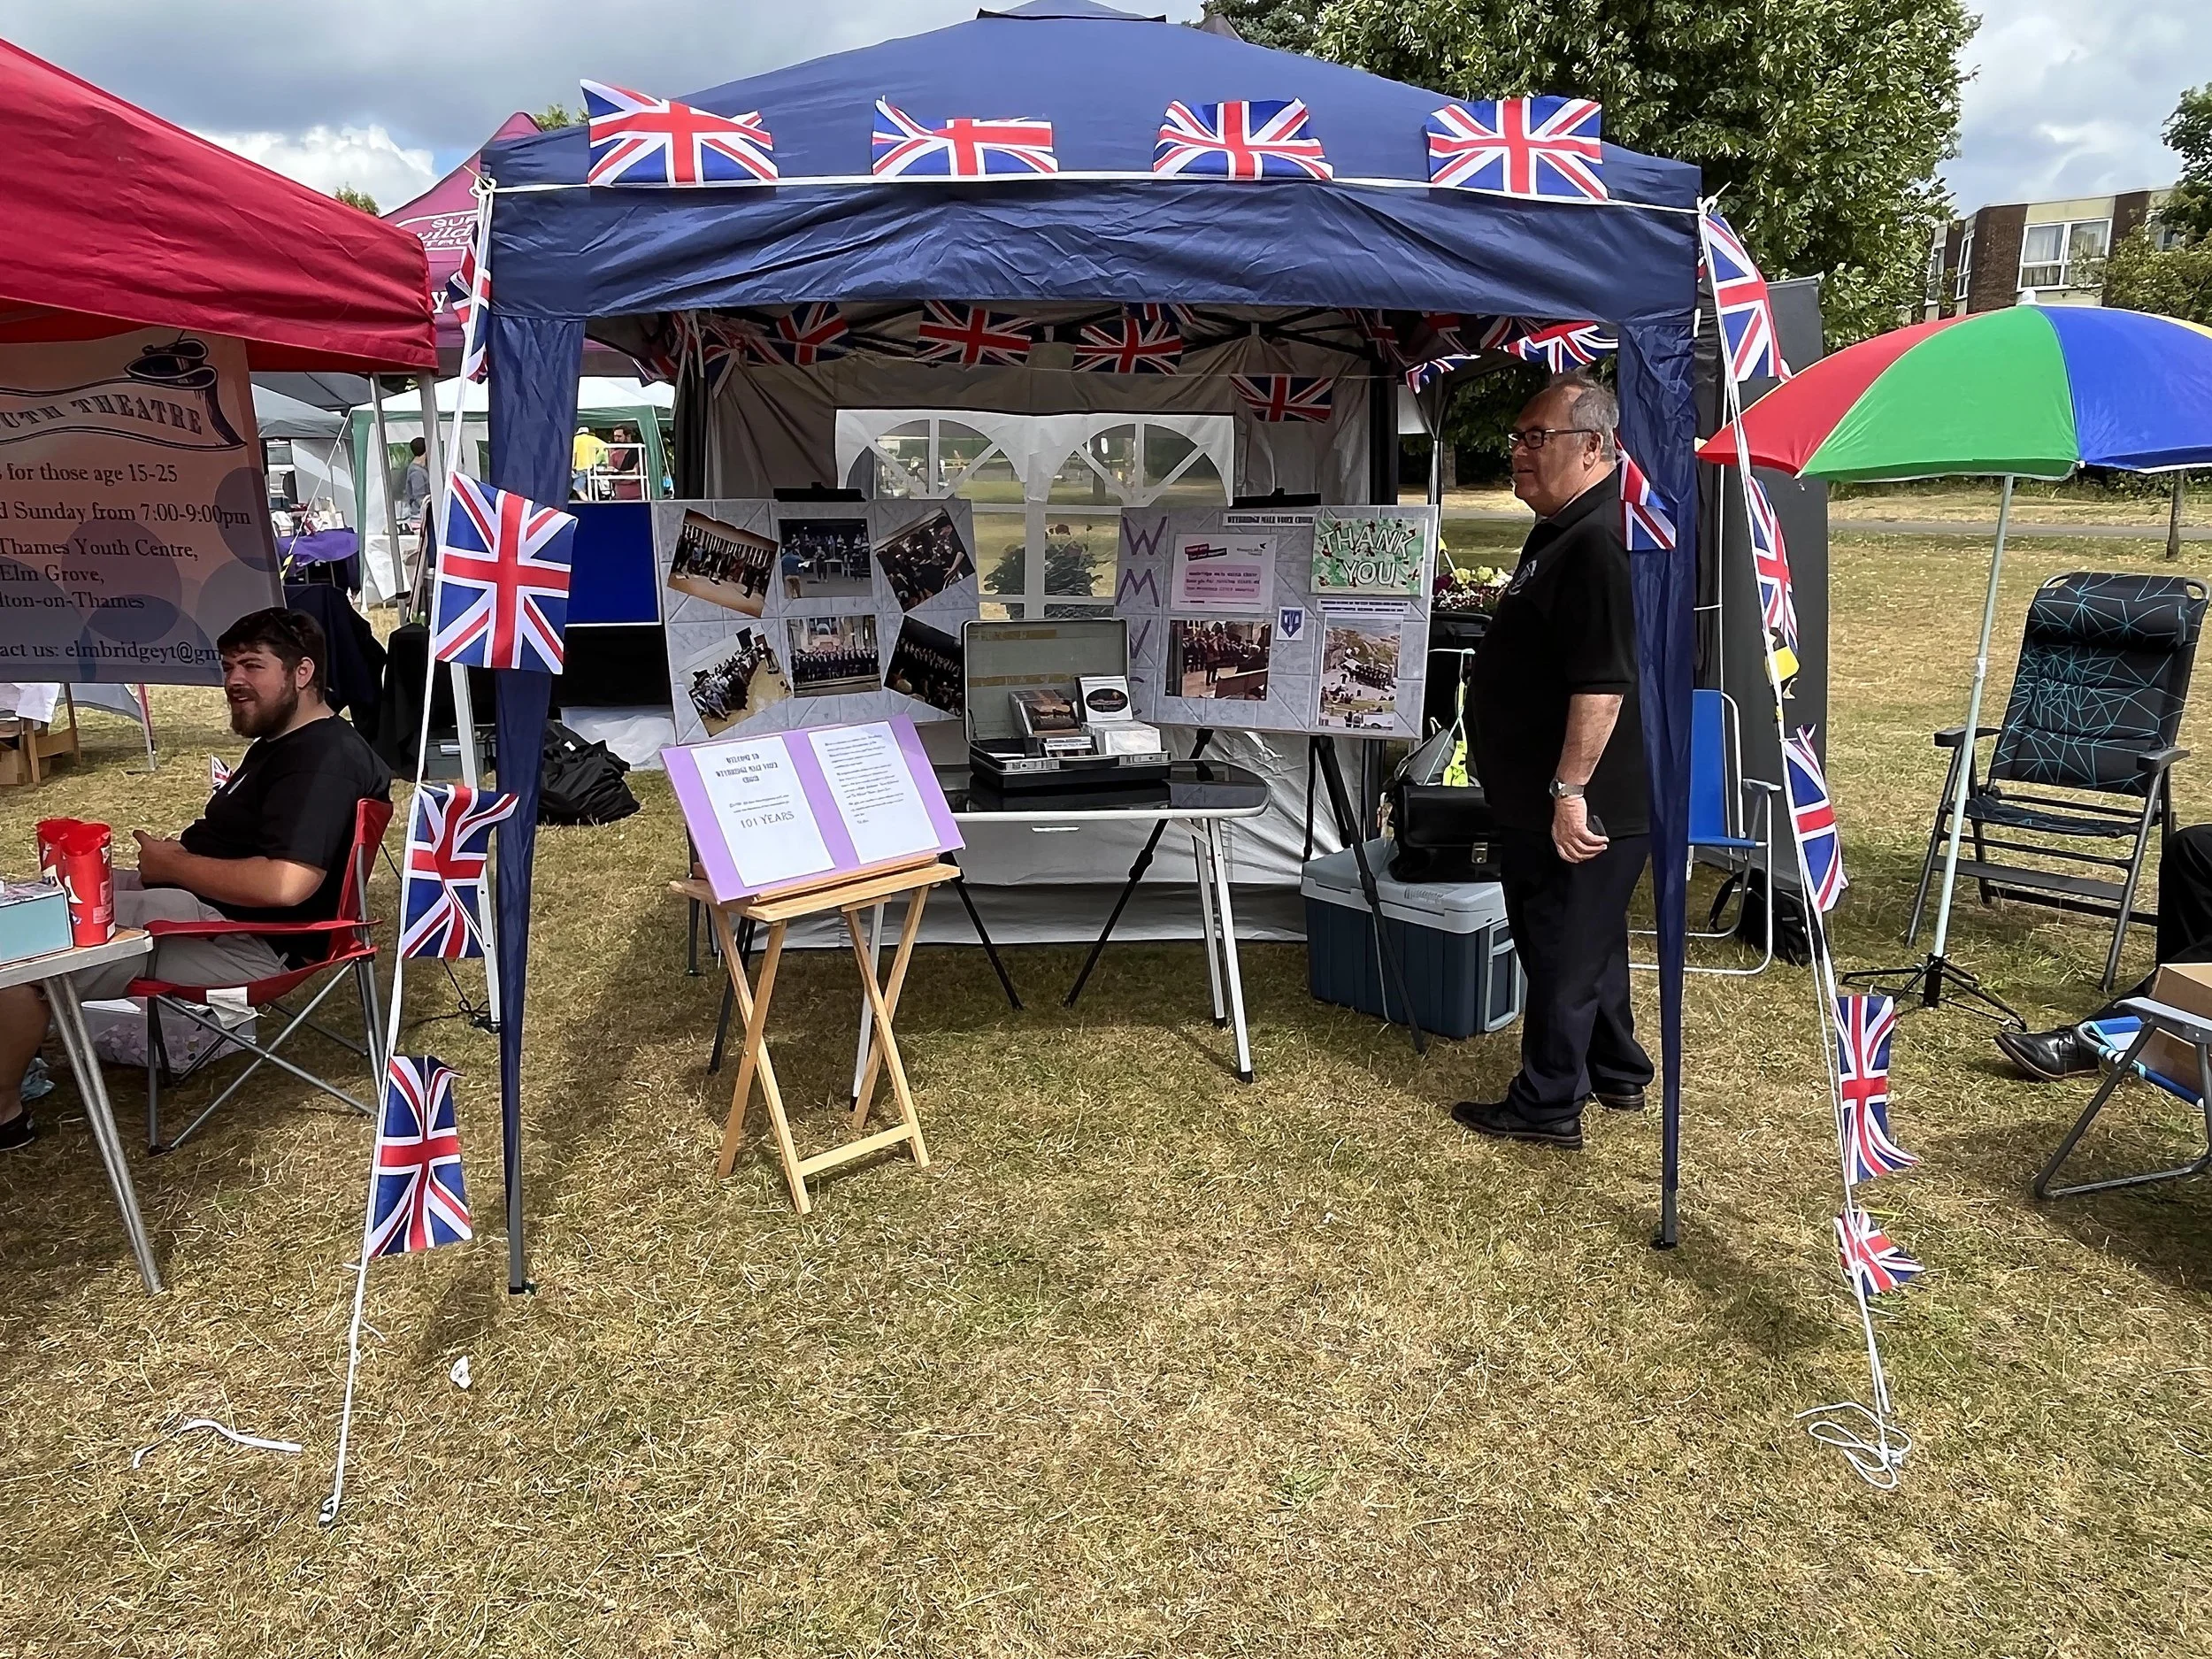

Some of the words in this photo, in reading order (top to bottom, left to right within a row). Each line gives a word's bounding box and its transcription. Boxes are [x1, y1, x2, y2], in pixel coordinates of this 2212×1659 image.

[69, 394, 202, 435] THEATRE
[7, 463, 34, 480] for
[40, 462, 88, 480] those
[94, 469, 124, 487] age
[128, 464, 178, 482] 15-25
[14, 501, 85, 525] Sunday
[92, 502, 135, 520] from
[140, 503, 251, 529] 7:00-9:00pm
[1123, 516, 1168, 556] W
[1318, 525, 1417, 558] THANK
[0, 538, 70, 555] Thames
[73, 538, 131, 556] Youth
[134, 539, 198, 562] Centre,
[0, 565, 39, 581] Elm
[44, 565, 104, 584] Grove,
[1343, 559, 1397, 586] YOU
[1116, 568, 1160, 608] M
[34, 645, 59, 657] us:
[741, 818, 758, 828] 101
[759, 810, 795, 825] YEARS
